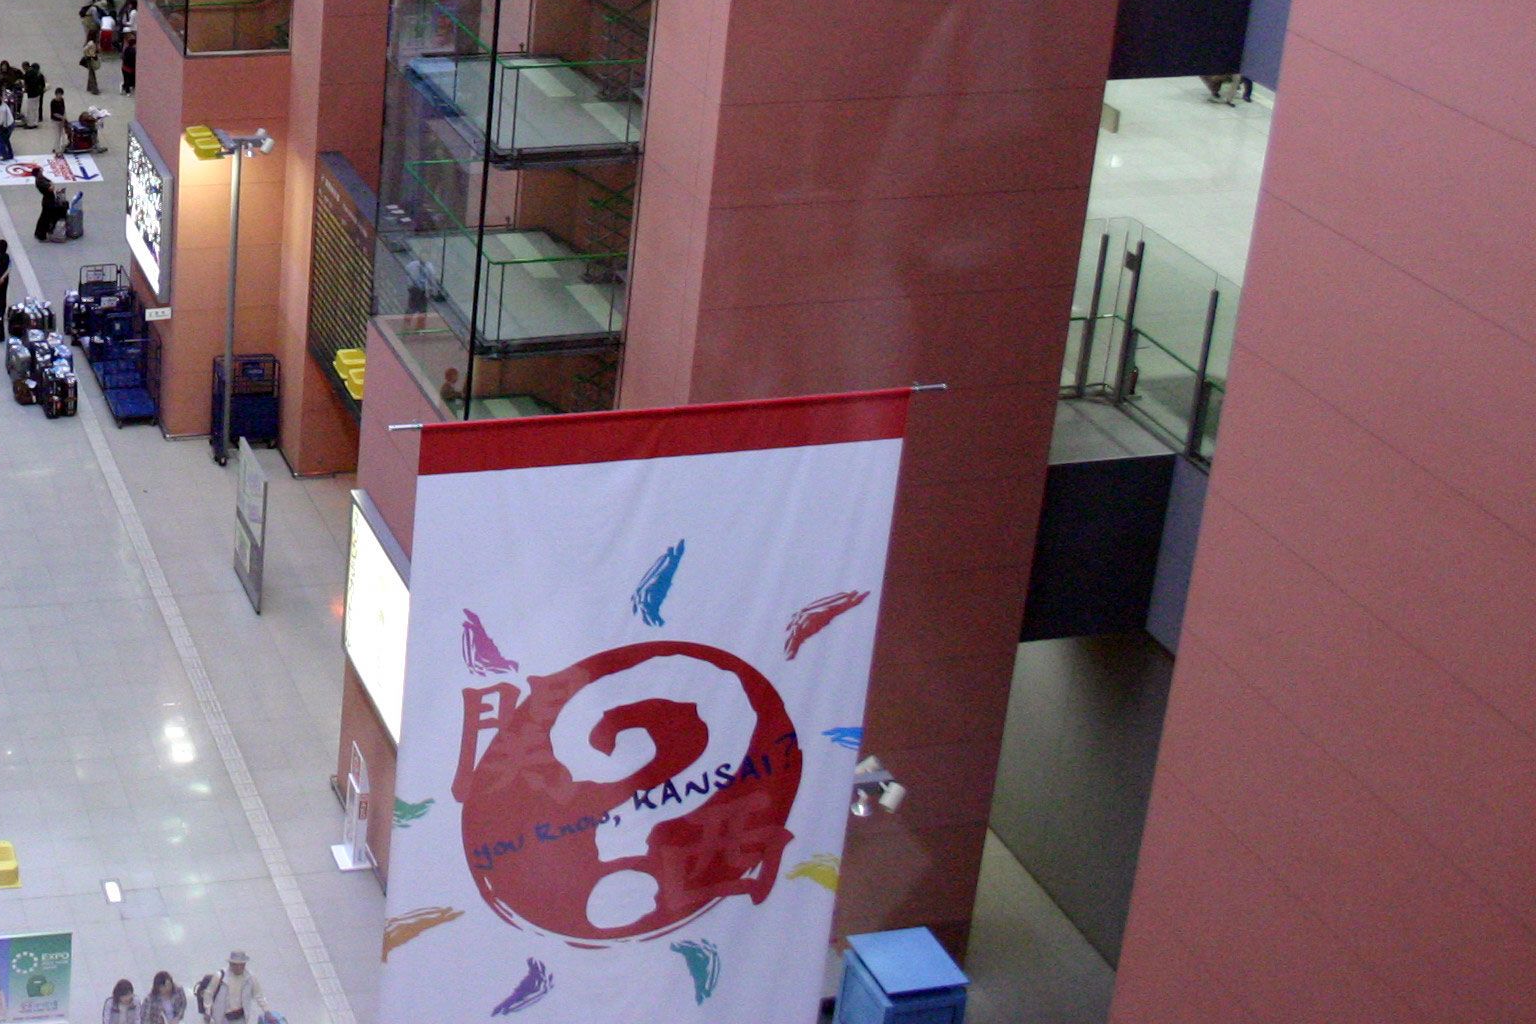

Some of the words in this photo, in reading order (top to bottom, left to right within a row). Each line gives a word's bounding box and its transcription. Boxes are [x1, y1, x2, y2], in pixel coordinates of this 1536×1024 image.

[474, 833, 524, 870] you
[632, 731, 798, 812] KANSAI?
[42, 952, 69, 960] EXPO
